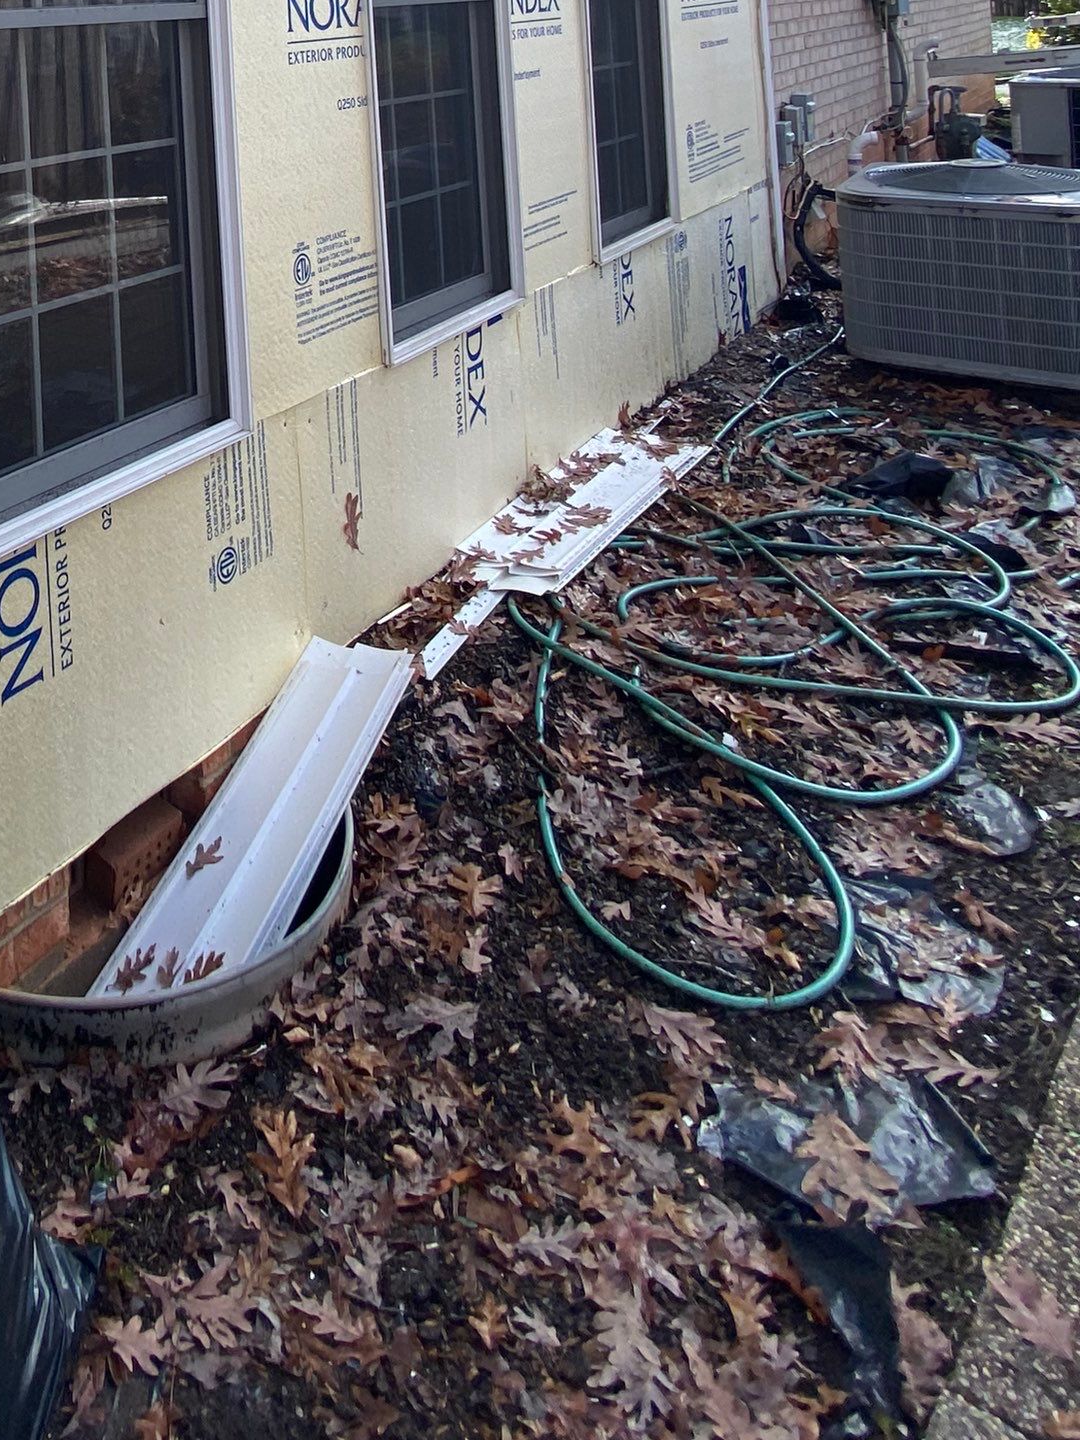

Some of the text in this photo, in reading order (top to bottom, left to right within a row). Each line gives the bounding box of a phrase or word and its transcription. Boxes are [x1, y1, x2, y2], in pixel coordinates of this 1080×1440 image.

[518, 26, 529, 41] FOR
[530, 24, 546, 38] YOUR
[288, 47, 334, 66] EXTERIOR
[337, 97, 355, 111] Q250
[453, 344, 465, 439] YOUR HOME
[204, 475, 213, 541] COMPLIANCE
[56, 555, 73, 671] EXTERIOR
